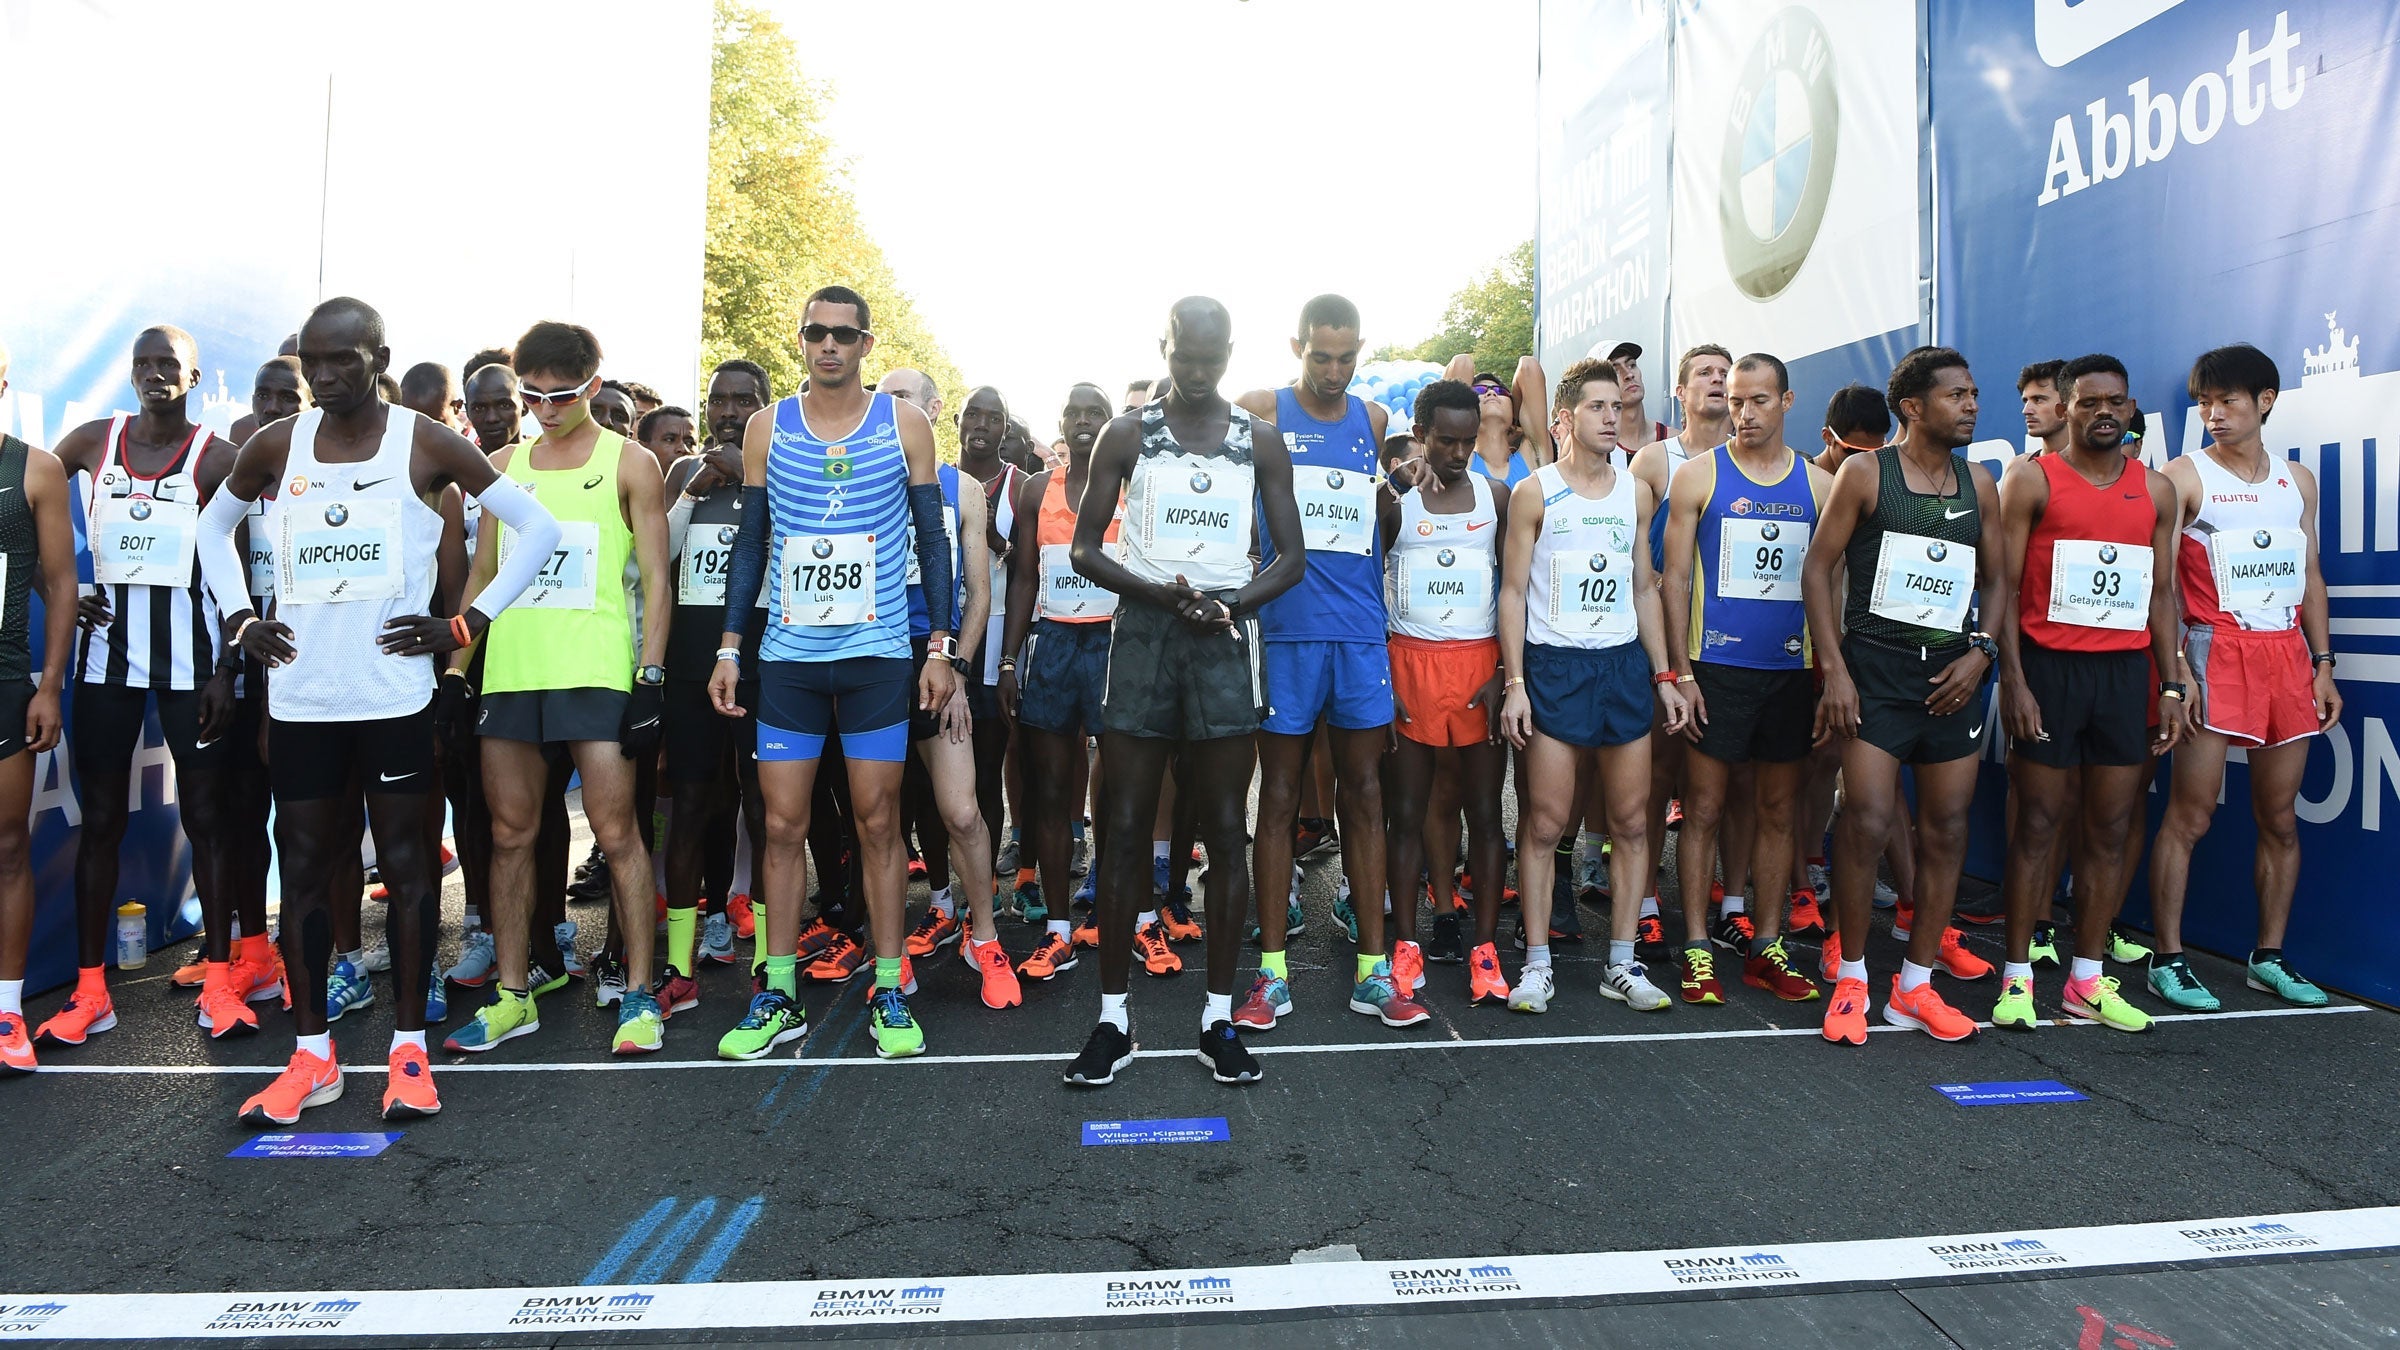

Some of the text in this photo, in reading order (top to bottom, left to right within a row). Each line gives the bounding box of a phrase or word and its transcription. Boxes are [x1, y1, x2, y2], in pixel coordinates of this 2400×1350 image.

[2037, 10, 2304, 206] Abbott
[1547, 218, 1607, 298] BERLIN
[1547, 252, 1649, 349] MARATHON
[2212, 494, 2258, 503] FUJITSU
[1305, 502, 1359, 522] DA SILVA
[1755, 502, 1803, 516] MPD
[1165, 508, 1230, 529] KIPSANG
[120, 535, 156, 551] BOIT
[299, 544, 381, 564] KIPCHOGE
[586, 548, 592, 556] A
[865, 560, 871, 568] A
[1755, 546, 1784, 572] 96
[1752, 571, 1782, 582] Vagner
[2231, 562, 2296, 580] NAKAMURA
[538, 578, 562, 588] Yong
[792, 563, 862, 592] 17858
[2092, 570, 2121, 596] 93
[1428, 582, 1464, 594] KUMA
[1578, 578, 1616, 602] 102
[1905, 573, 1954, 596] TADESE
[814, 593, 834, 602] Luis
[2069, 594, 2134, 609] Getaye Fisseha
[1582, 604, 1611, 612] Alessio
[1153, 1130, 1214, 1138] Kipsang
[2179, 1226, 2250, 1240] BMW
[1927, 1242, 2002, 1255] BMW
[2205, 1238, 2320, 1253] MARATHON
[1663, 1256, 1735, 1269] BMW
[1938, 1252, 2016, 1262] BERLIN
[1947, 1255, 2069, 1270] MARATHON
[1388, 1268, 1462, 1280] BMW
[1670, 1266, 1749, 1277] BERLIN
[1676, 1271, 1801, 1284] MARATHON
[1106, 1280, 1182, 1292] BMW
[1392, 1278, 1471, 1288] BERLIN
[818, 1289, 896, 1300] BMW
[1106, 1290, 1184, 1300] BERLIN
[1395, 1284, 1522, 1296] MARATHON
[227, 1302, 312, 1312] BMW
[522, 1296, 605, 1308] BMW
[812, 1300, 894, 1309] BERLIN
[1106, 1296, 1235, 1308] MARATHON
[216, 1313, 301, 1322] BERLIN
[514, 1307, 599, 1316] BERLIN
[808, 1306, 940, 1318] MARATHON
[204, 1320, 342, 1330] MARATHON
[508, 1314, 643, 1325] MARATHON
